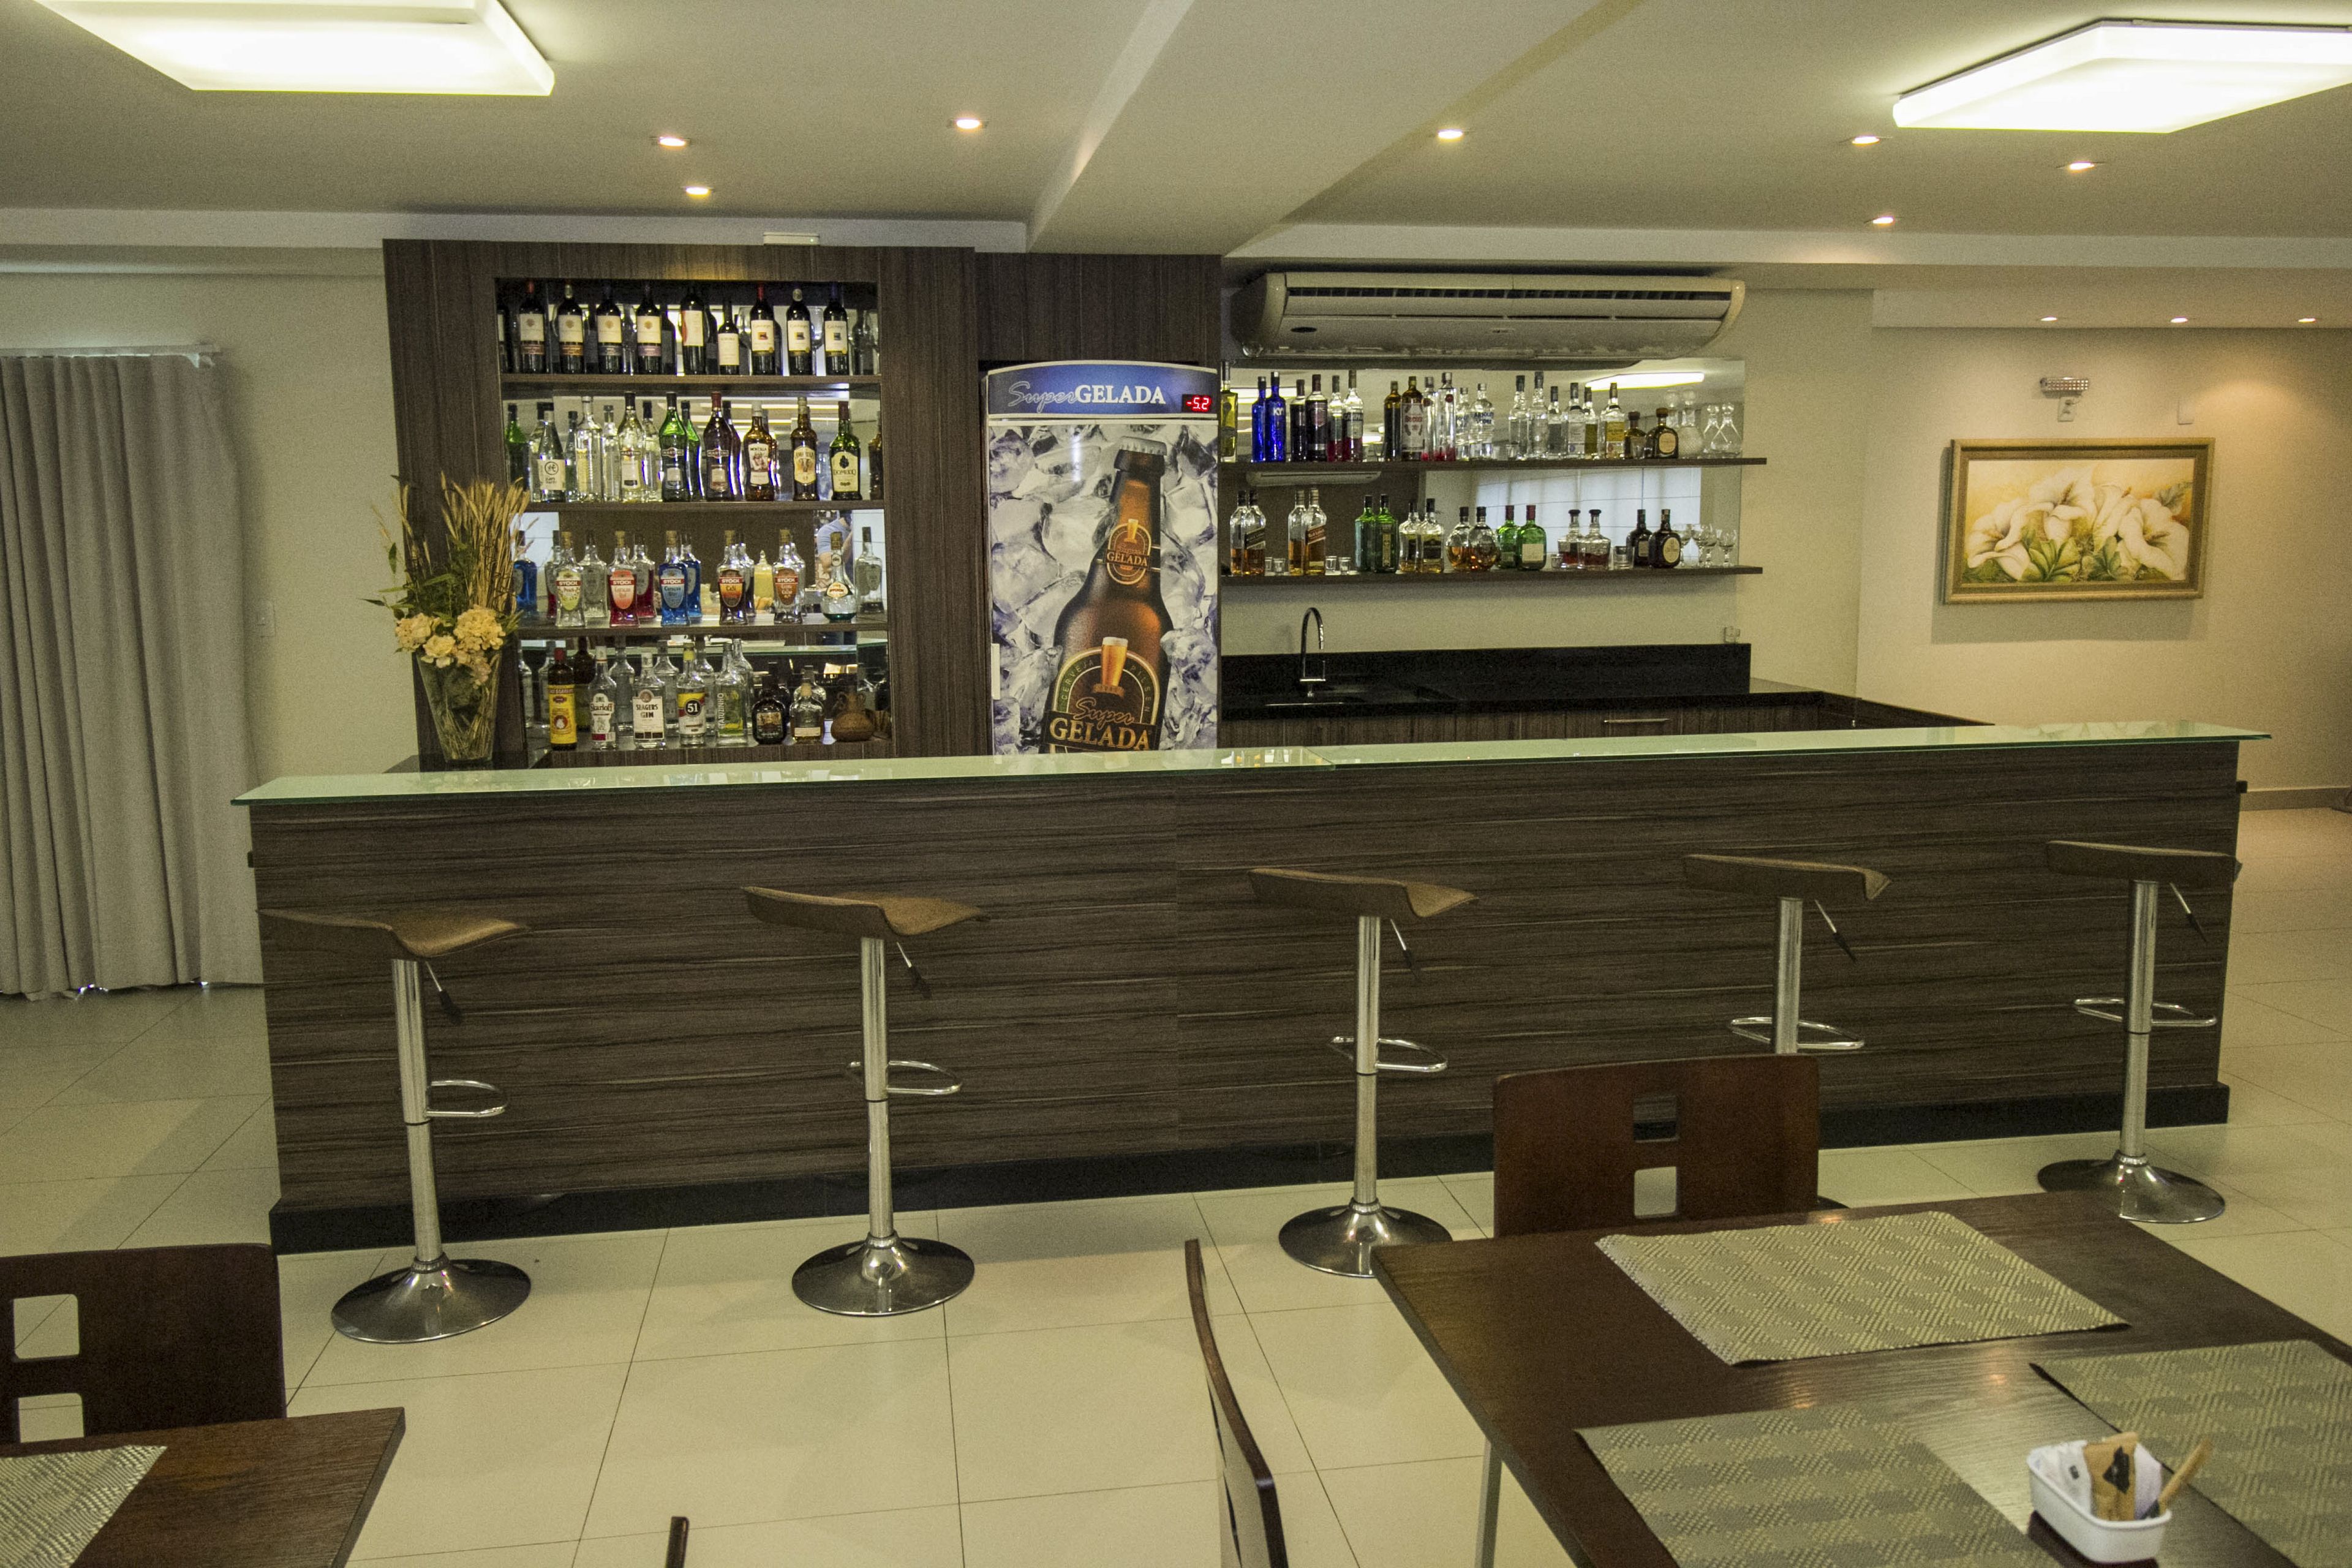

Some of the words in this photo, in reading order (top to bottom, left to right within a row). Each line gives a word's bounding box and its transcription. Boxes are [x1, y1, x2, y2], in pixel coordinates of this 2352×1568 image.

[1074, 385, 1167, 405] GELADA
[1107, 551, 1147, 566] GELADA
[1061, 658, 1094, 701] CERVEJA
[687, 703, 698, 712] 51
[1073, 696, 1135, 731] Super
[1049, 717, 1150, 751] GELADA
